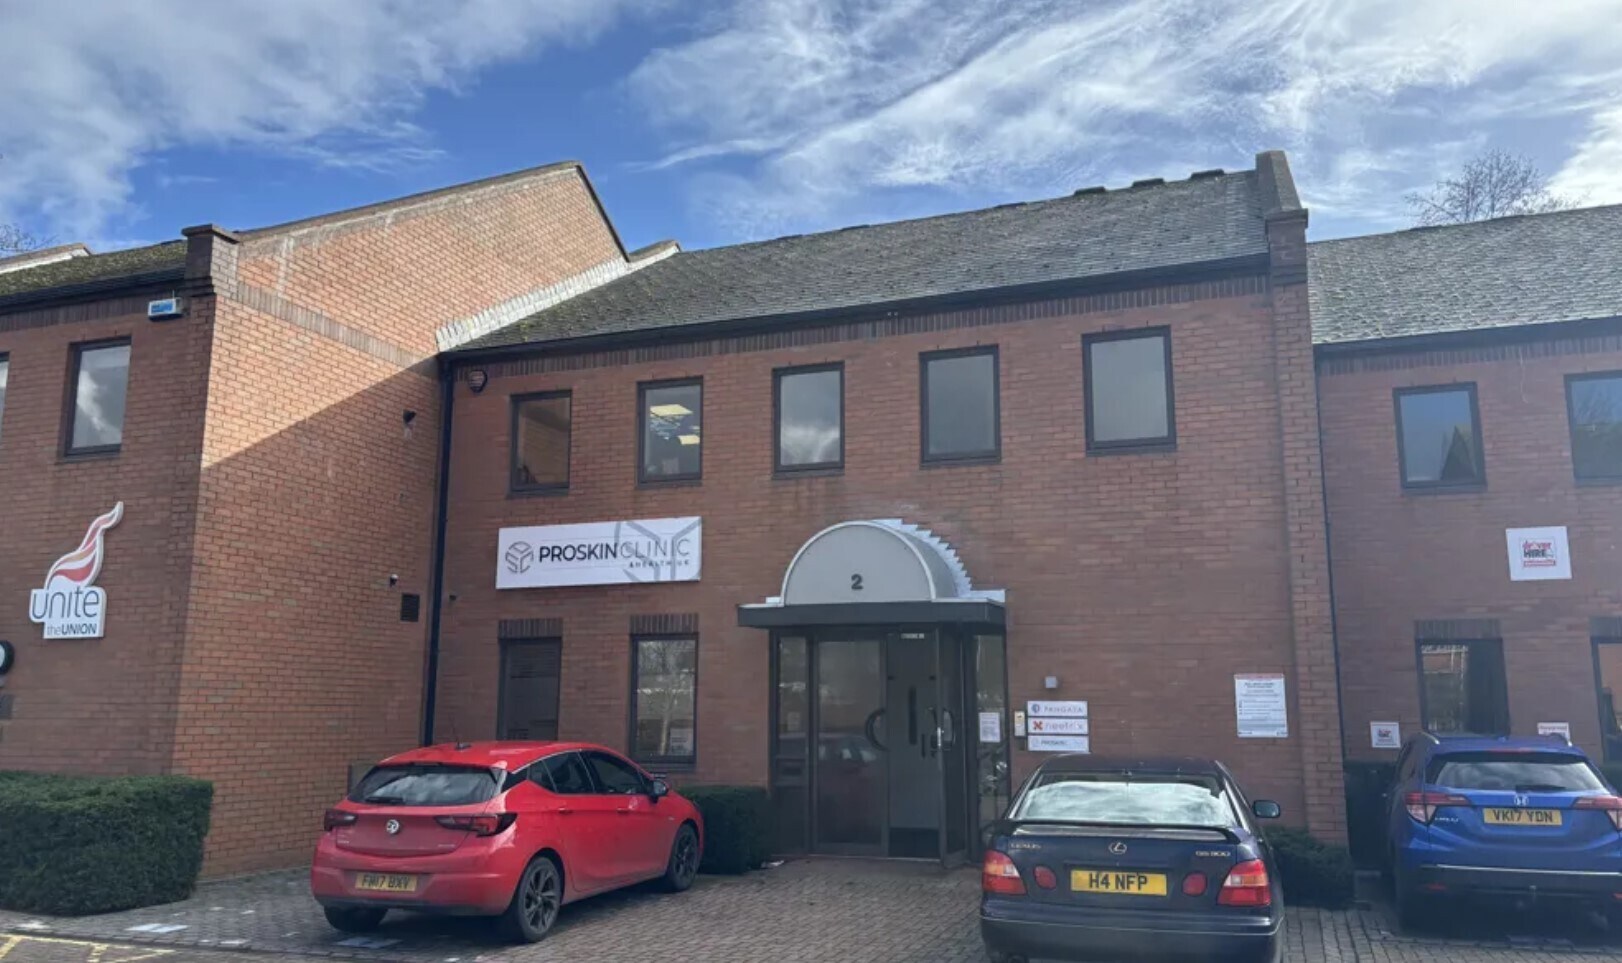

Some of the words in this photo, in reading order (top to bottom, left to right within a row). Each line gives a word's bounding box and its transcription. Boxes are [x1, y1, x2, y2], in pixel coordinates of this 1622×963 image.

[851, 573, 864, 590] 2
[31, 586, 100, 619] unite
[1491, 809, 1521, 822] VK17
[1526, 810, 1554, 823] YDN
[1088, 872, 1111, 886] H4
[1114, 873, 1149, 891] NFP
